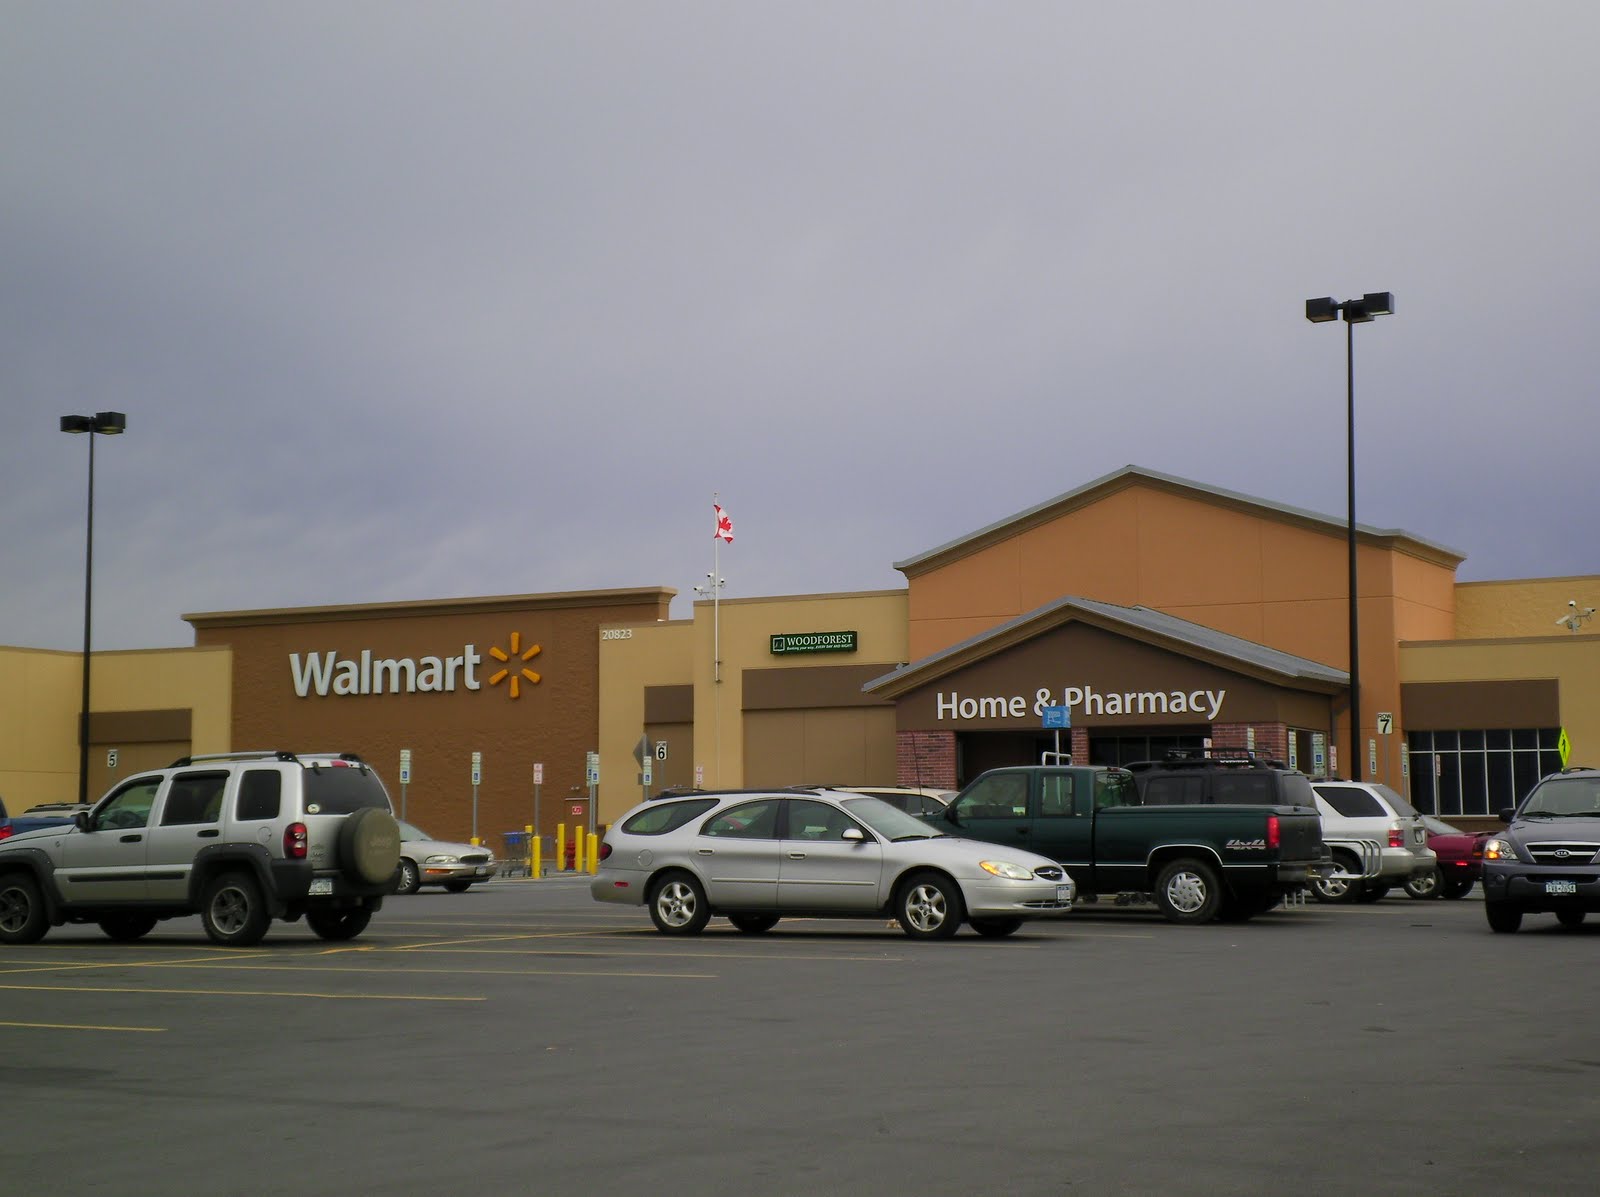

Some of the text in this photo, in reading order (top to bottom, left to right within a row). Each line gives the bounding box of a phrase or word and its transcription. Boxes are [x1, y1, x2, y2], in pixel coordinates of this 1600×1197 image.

[602, 630, 632, 640] 20823
[786, 634, 853, 646] WOODFOREST
[289, 645, 480, 697] Walmart
[937, 686, 1226, 720] Home & Pharmacy
[1380, 719, 1390, 733] 7
[658, 747, 665, 759] 6
[109, 755, 115, 766] 5
[1226, 840, 1266, 850] 4x4
